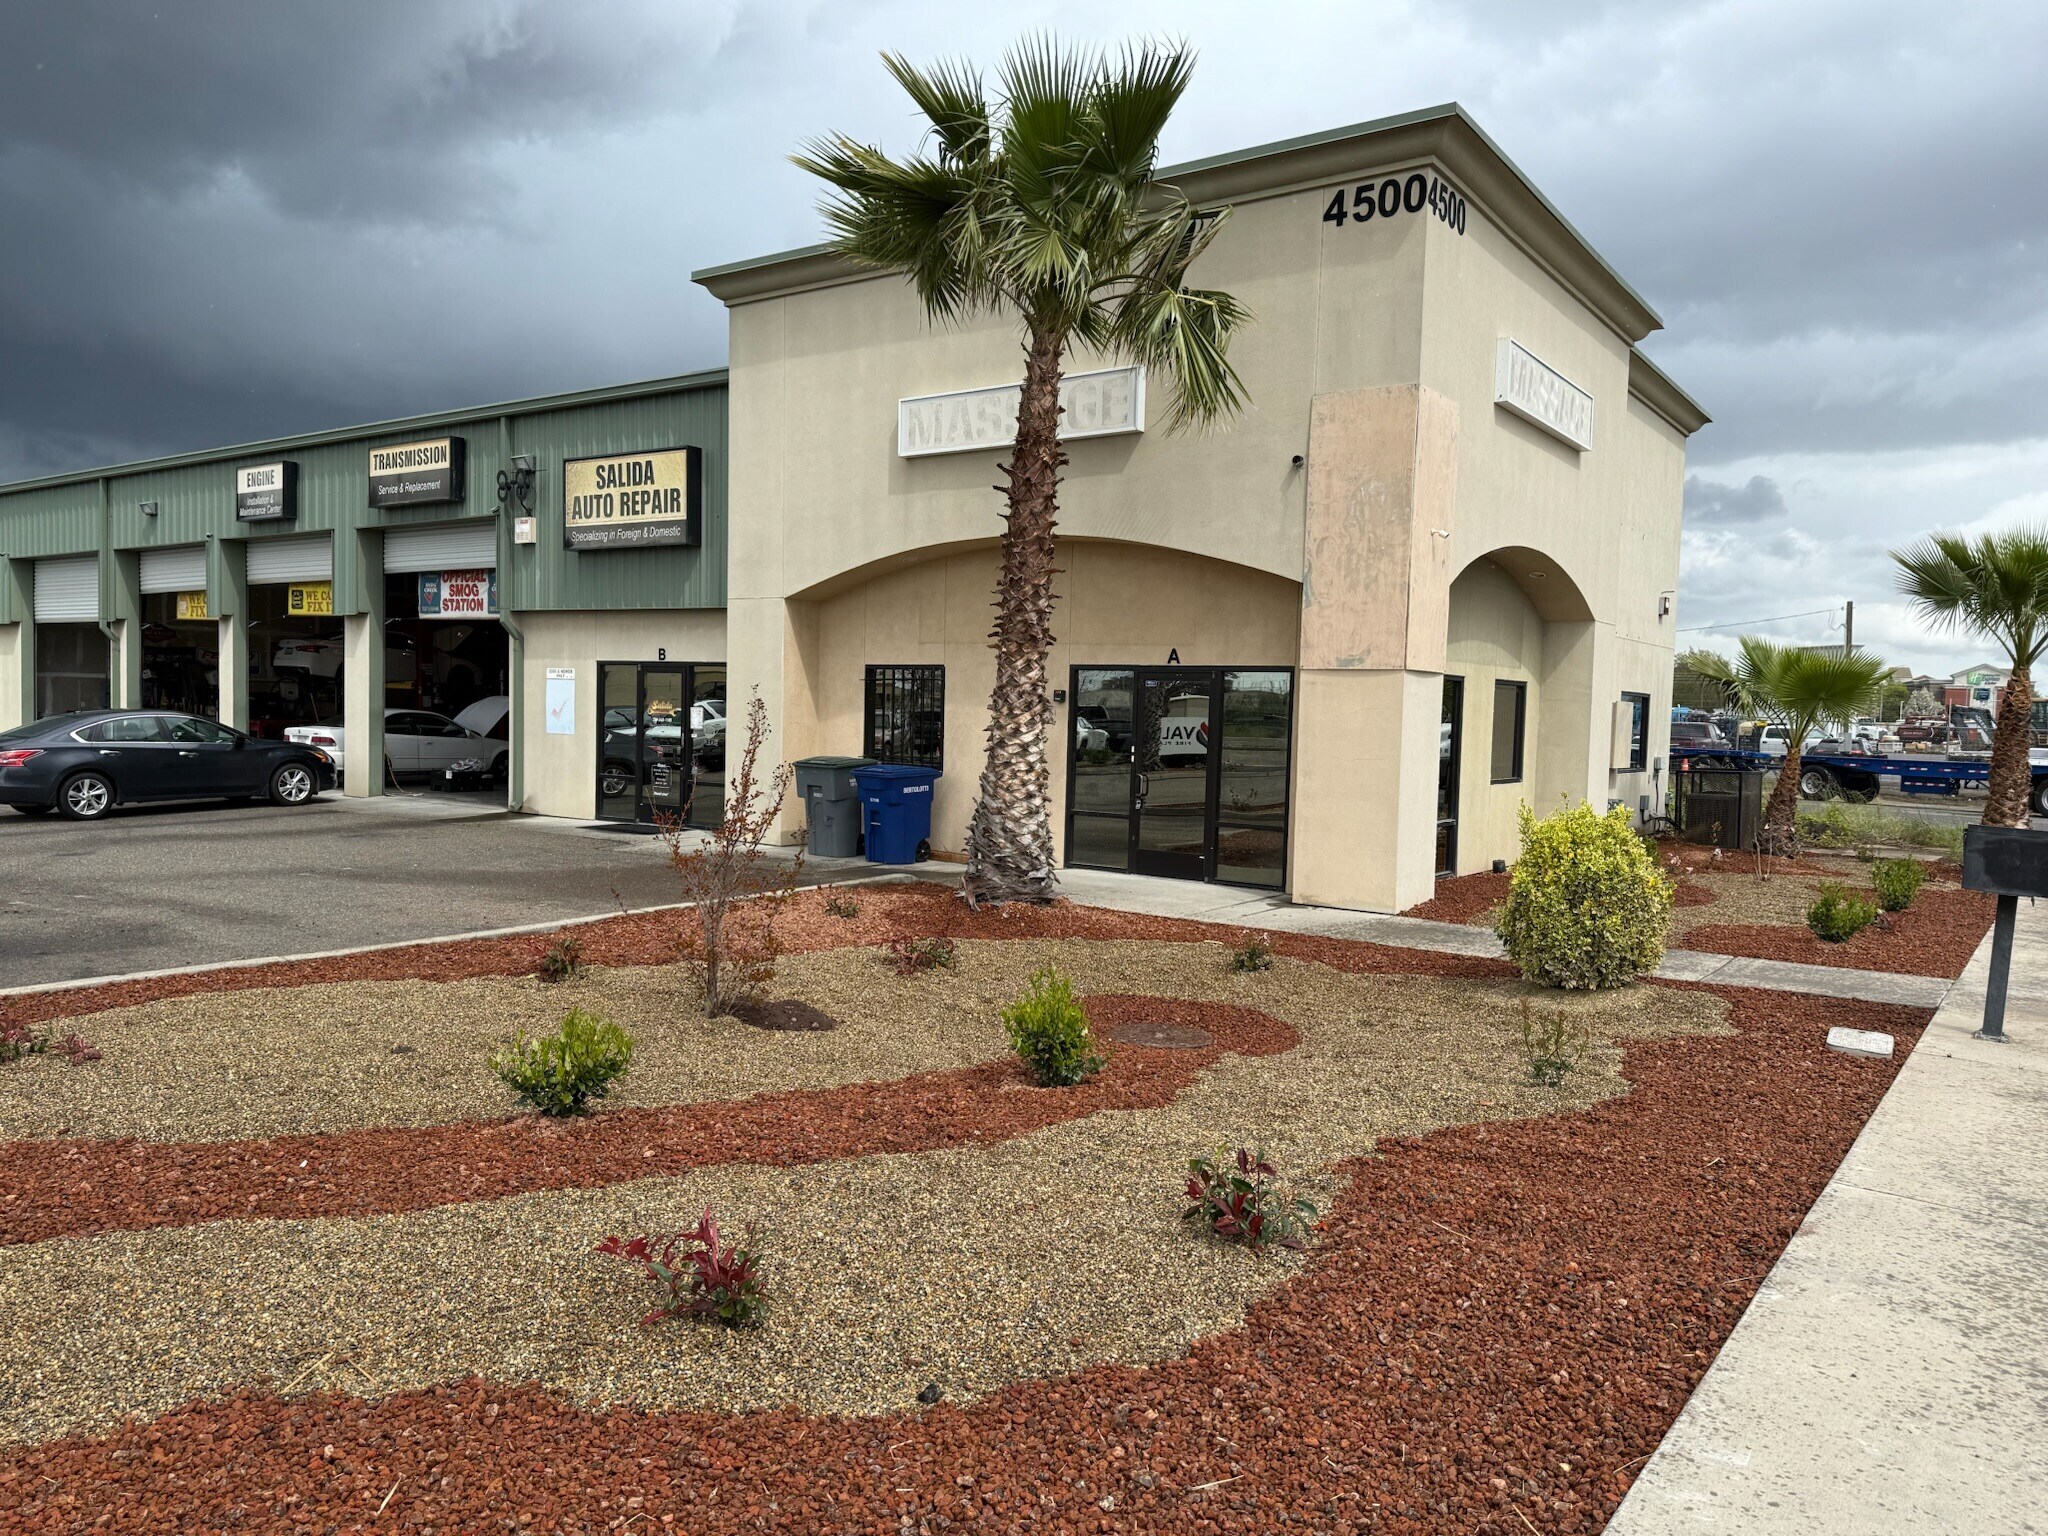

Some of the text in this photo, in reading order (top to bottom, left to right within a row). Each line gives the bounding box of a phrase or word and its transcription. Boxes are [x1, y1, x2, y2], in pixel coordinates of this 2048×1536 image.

[1323, 174, 1427, 227] 4500
[1428, 177, 1466, 236] 4500
[908, 375, 1130, 448] MASSGE
[373, 445, 447, 471] TRANSMISSION
[247, 469, 275, 488] ENGINE
[596, 460, 655, 490] SALIDA
[378, 480, 441, 495] Service & Replacement
[572, 487, 681, 520] AUTO REPAIR
[572, 525, 681, 543] Specializing in Foreign & Domestic
[442, 569, 487, 583] OFFICIAL
[305, 590, 319, 601] WE
[320, 590, 332, 601] CA
[449, 583, 480, 597] SMOG
[188, 593, 202, 605] WE
[307, 601, 324, 612] FIX
[442, 598, 484, 612] STATION
[190, 605, 206, 617] FIX
[658, 648, 666, 661] B
[1167, 648, 1180, 664] A
